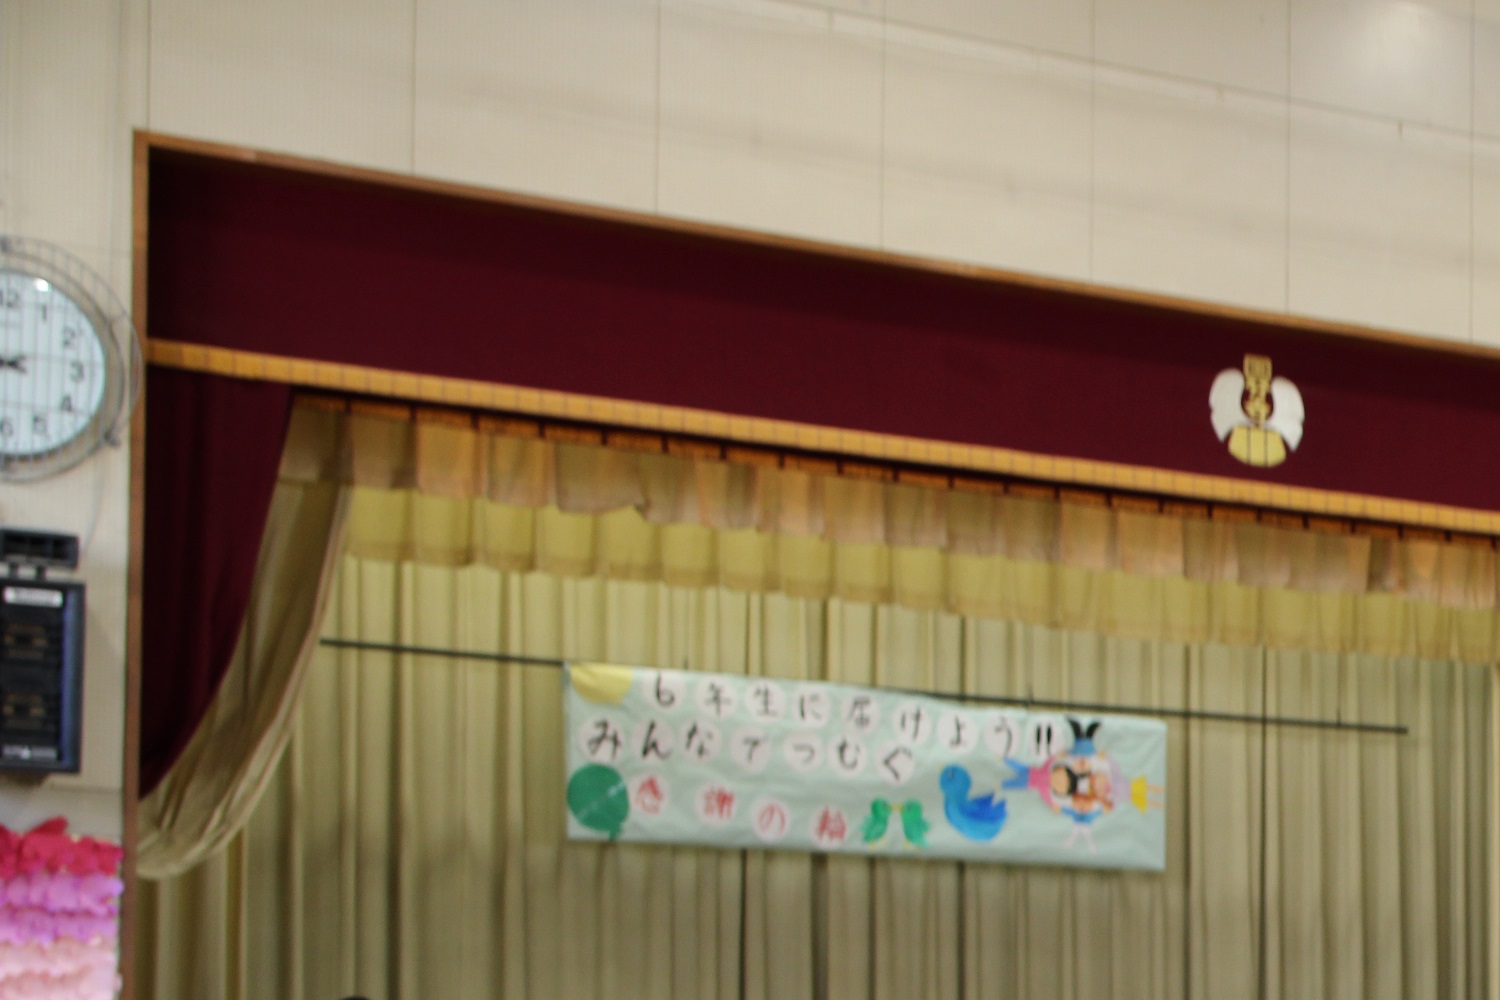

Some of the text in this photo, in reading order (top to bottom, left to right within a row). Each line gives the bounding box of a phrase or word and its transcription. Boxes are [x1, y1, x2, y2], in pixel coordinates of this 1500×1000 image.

[62, 325, 76, 349] 2
[69, 359, 85, 384] 3
[60, 395, 73, 413] 4
